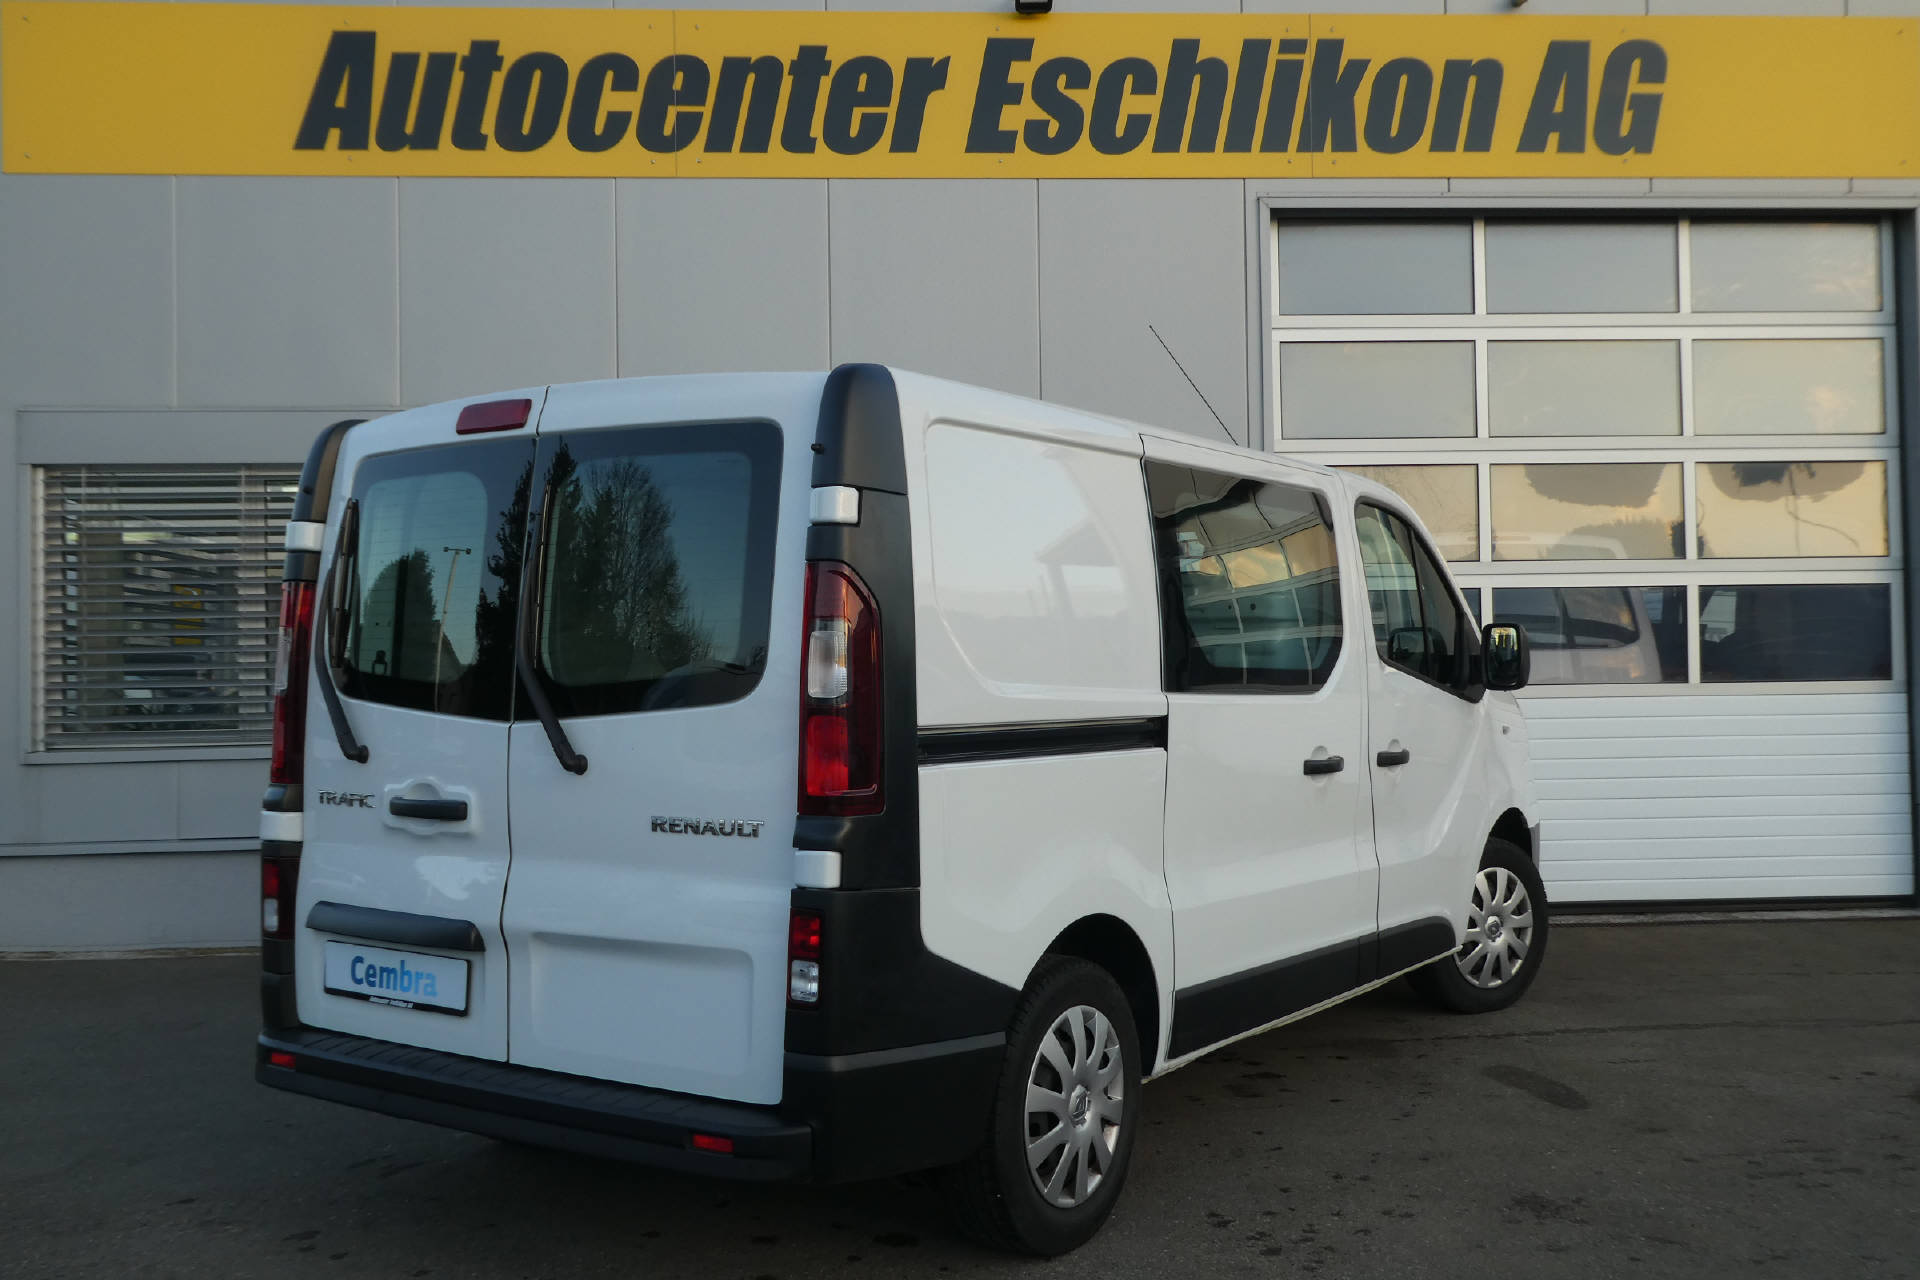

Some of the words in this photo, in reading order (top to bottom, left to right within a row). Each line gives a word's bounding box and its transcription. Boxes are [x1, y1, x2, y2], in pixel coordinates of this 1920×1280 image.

[293, 30, 952, 155] Autocenter
[965, 37, 1504, 155] Eschlikon
[1516, 39, 1669, 156] AG
[318, 790, 376, 808] TRAFIC
[651, 816, 764, 838] RENAULT
[351, 955, 438, 997] Cembra
